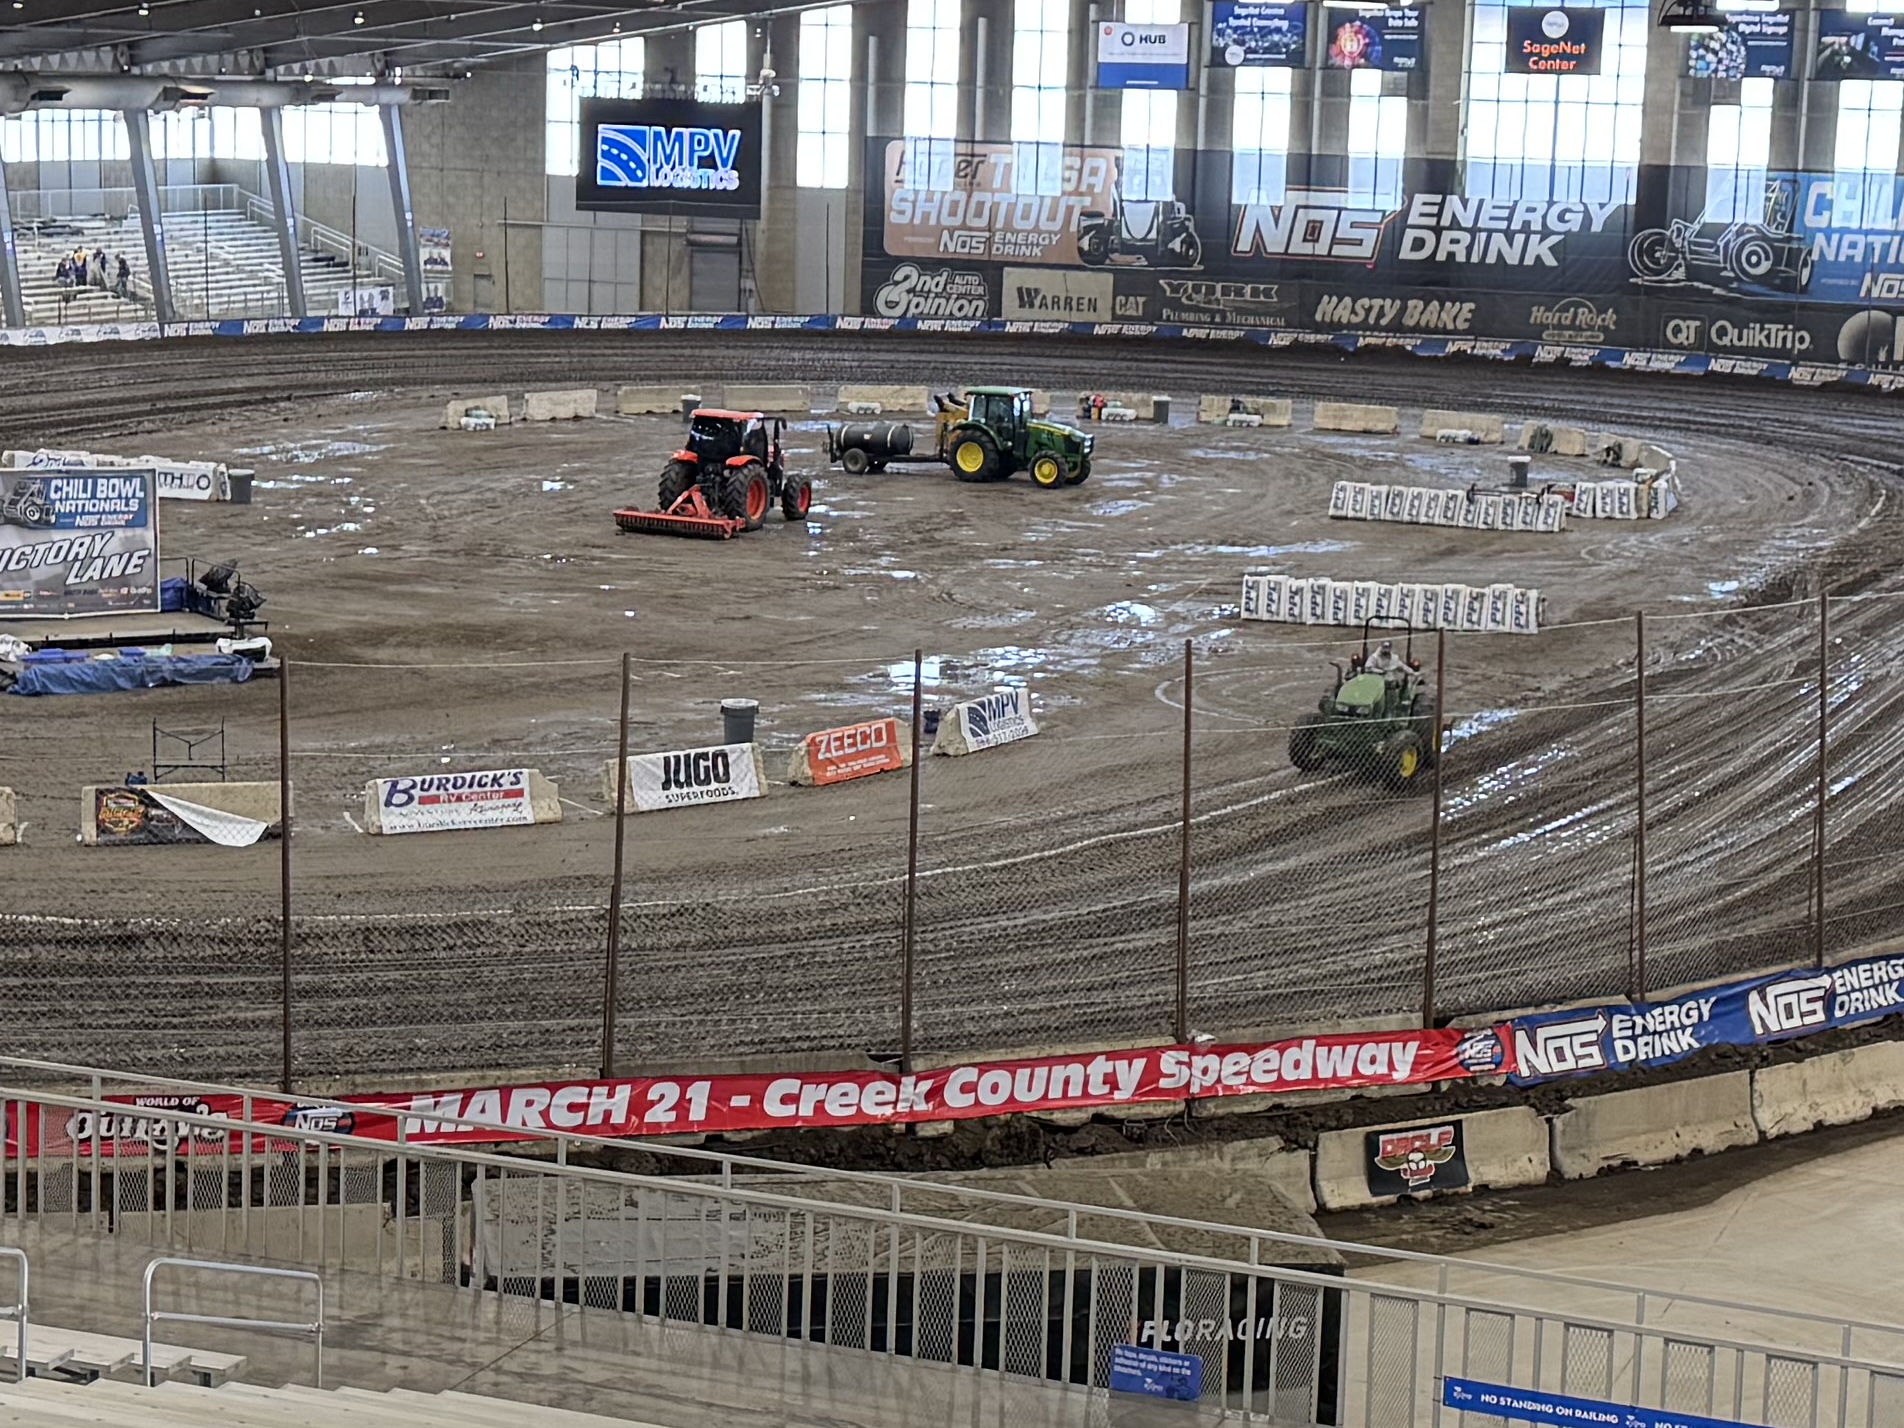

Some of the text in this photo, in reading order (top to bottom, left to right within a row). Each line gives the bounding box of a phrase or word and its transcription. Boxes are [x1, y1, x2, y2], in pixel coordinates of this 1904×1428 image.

[1138, 33, 1167, 45] HUB
[1522, 39, 1586, 57] SageNet
[1528, 56, 1577, 71] Center
[650, 126, 742, 170] MPV
[650, 166, 740, 190] LOGISTICS
[889, 188, 1093, 233] SHOOTOUT
[1234, 192, 1623, 260] NOS ENERGY
[939, 229, 1062, 256] NOS ENERGY
[992, 243, 1045, 258] DRINK
[1398, 228, 1566, 267] DRINK
[946, 283, 987, 295] CENTER
[953, 274, 980, 286] AUTO
[1158, 278, 1279, 302] YORK
[1016, 285, 1099, 315] WARREN
[1115, 294, 1147, 317] CAT
[1314, 295, 1476, 331] HASTY BAKE
[1161, 308, 1287, 327] PLUMBING & MECHANICAL
[1530, 305, 1618, 331] Hard Rock
[1665, 319, 1812, 351] QT QuikTrip
[49, 478, 93, 500] CHILI
[96, 478, 145, 498] BOWL
[54, 498, 139, 515] NATIONALS
[65, 548, 151, 585] LANE
[986, 691, 1020, 722] MPV
[817, 724, 887, 760] ZEECO
[661, 749, 731, 791] JUGO
[383, 770, 521, 808] BURDICK'S
[439, 790, 506, 804] RV Center
[1748, 974, 1834, 1036] NOS
[1514, 996, 1718, 1078] NOS ENERGY
[1614, 1027, 1701, 1063] DRINK
[405, 1039, 1420, 1134] MARCH 21 - Creek County Speedway
[135, 1095, 201, 1108] WORLD OF
[295, 1115, 337, 1133] NOS
[1480, 1392, 1498, 1404] NO
[1499, 1396, 1554, 1415] STANDING
[1555, 1405, 1573, 1417] ON
[1574, 1408, 1619, 1425] RAILING
